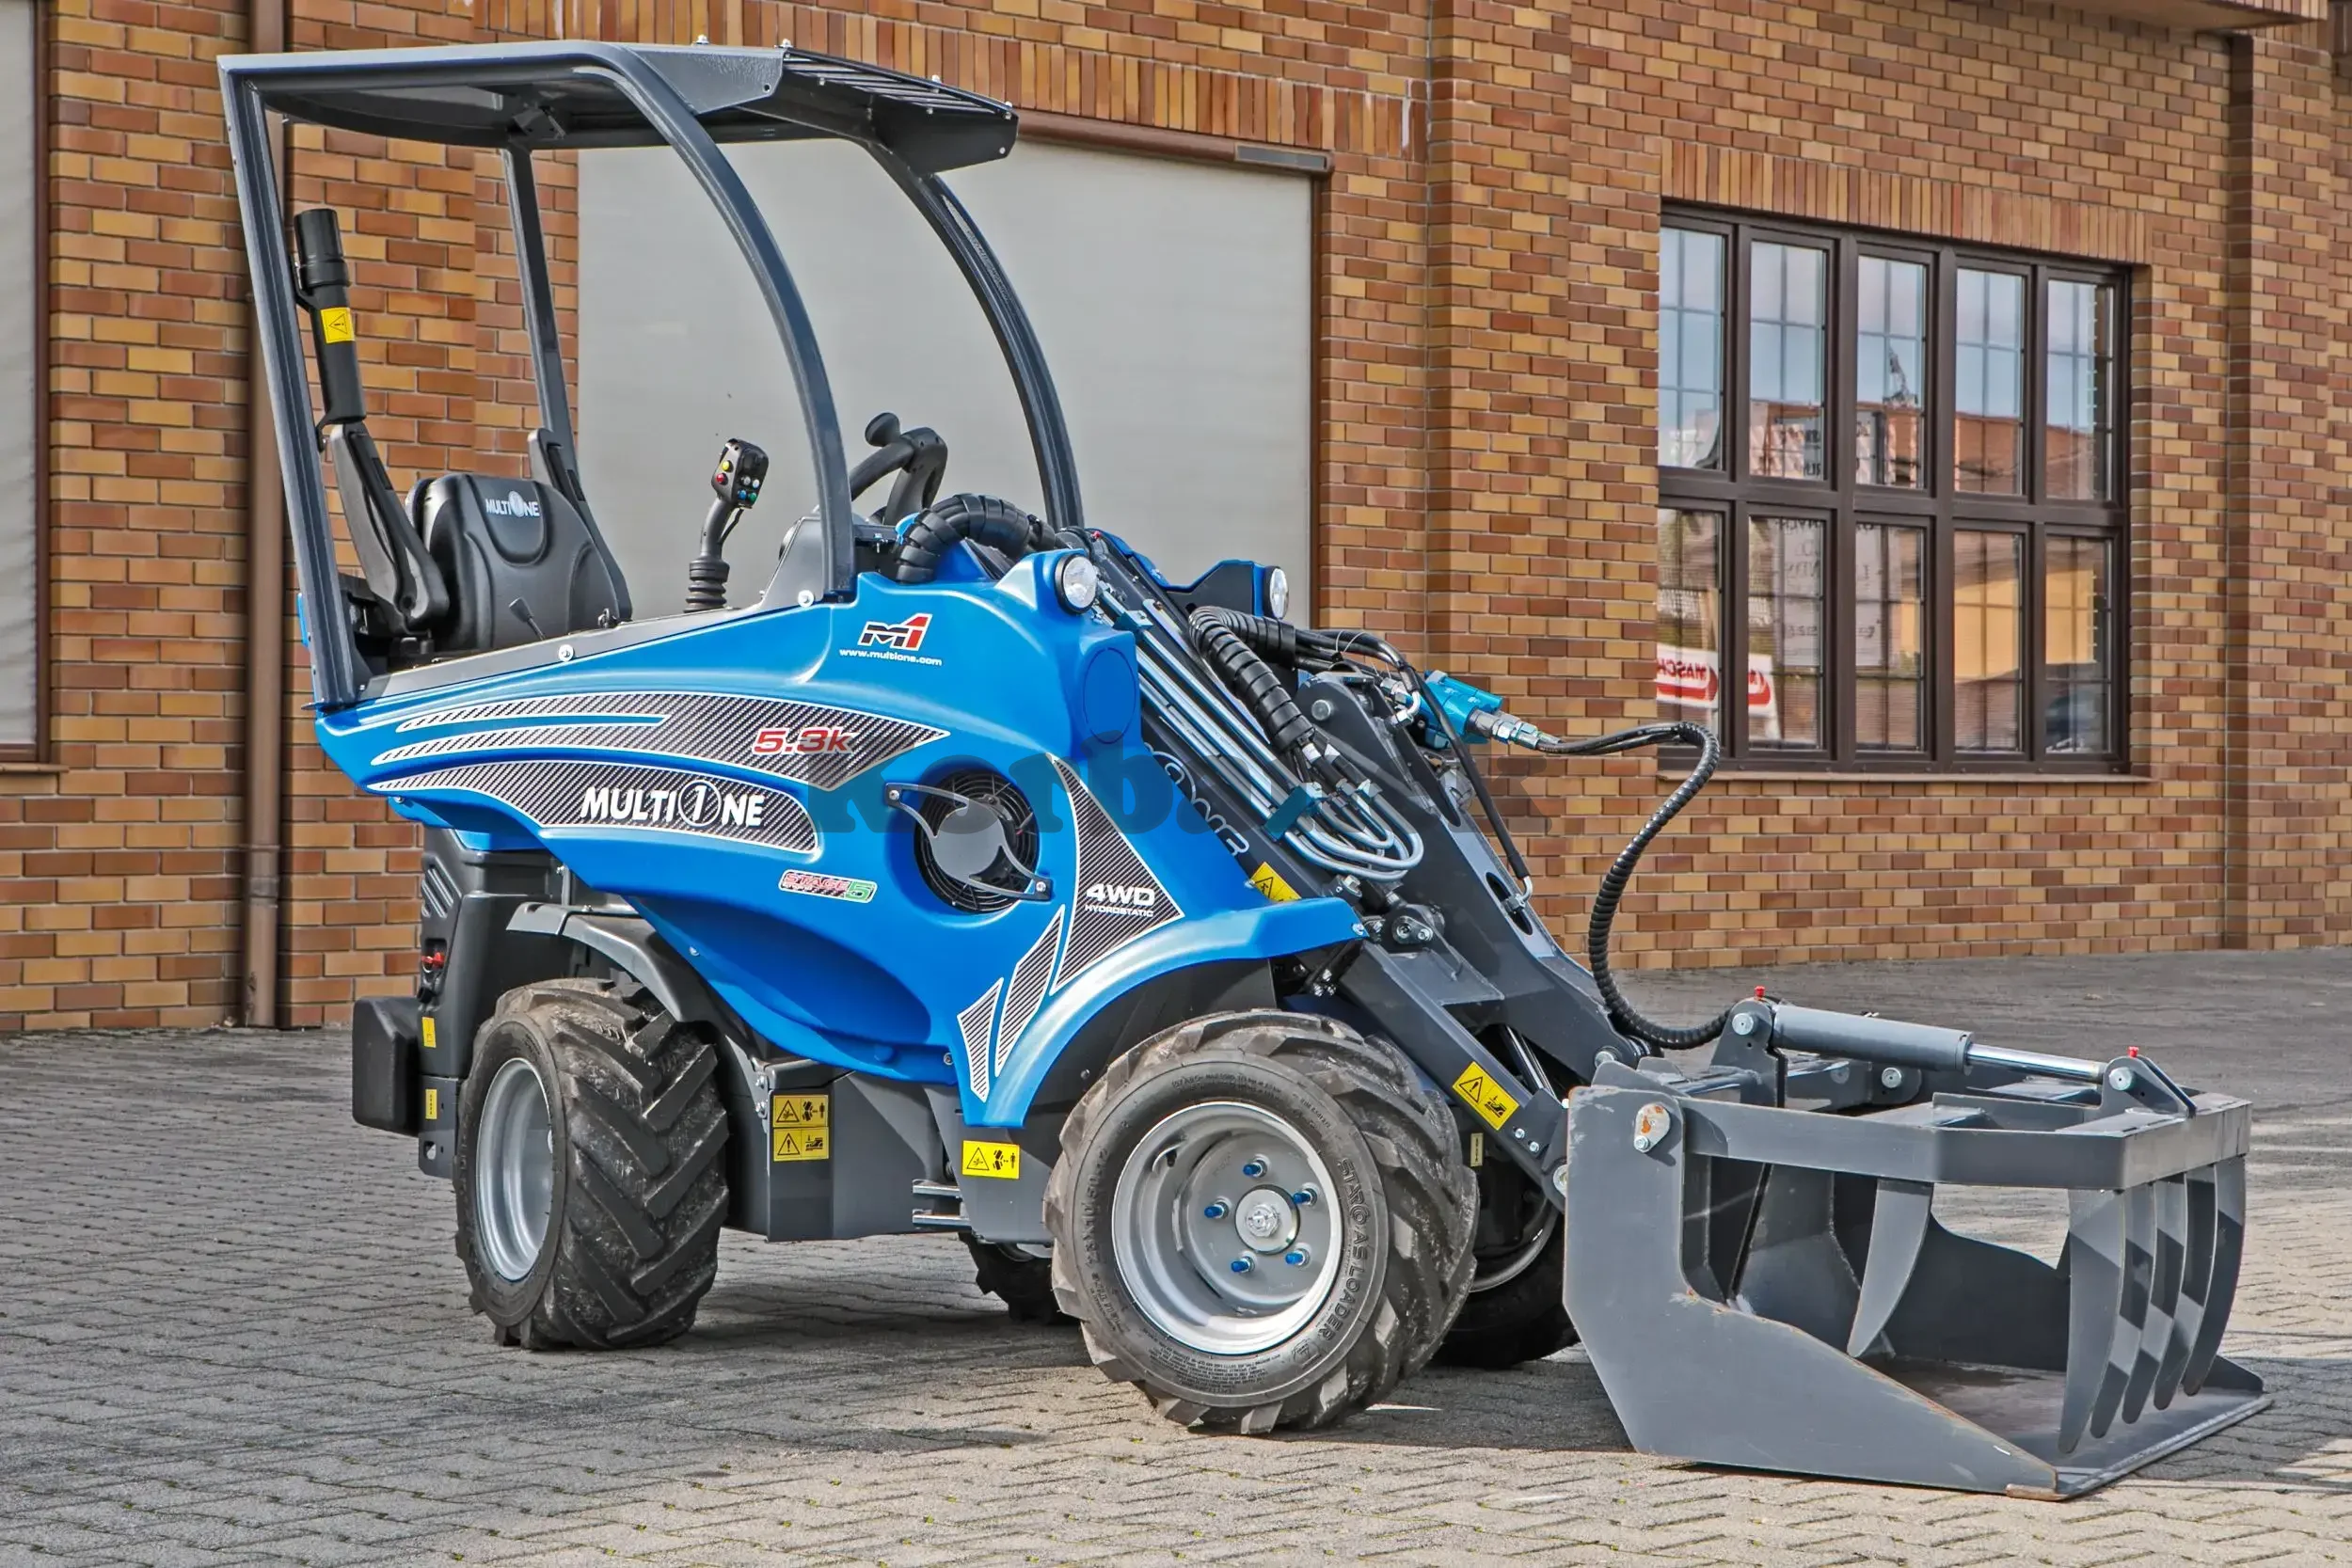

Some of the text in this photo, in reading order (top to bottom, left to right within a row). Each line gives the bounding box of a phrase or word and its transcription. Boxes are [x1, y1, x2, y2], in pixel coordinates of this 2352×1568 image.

[838, 648, 943, 667] www.multione.com
[784, 871, 850, 892] STAGE
[846, 880, 876, 901] 5
[1086, 882, 1155, 907] 4WD
[1085, 904, 1154, 918] HYDROSTATIC
[1353, 1228, 1370, 1260] AS
[1317, 1263, 1365, 1343] LOADER
